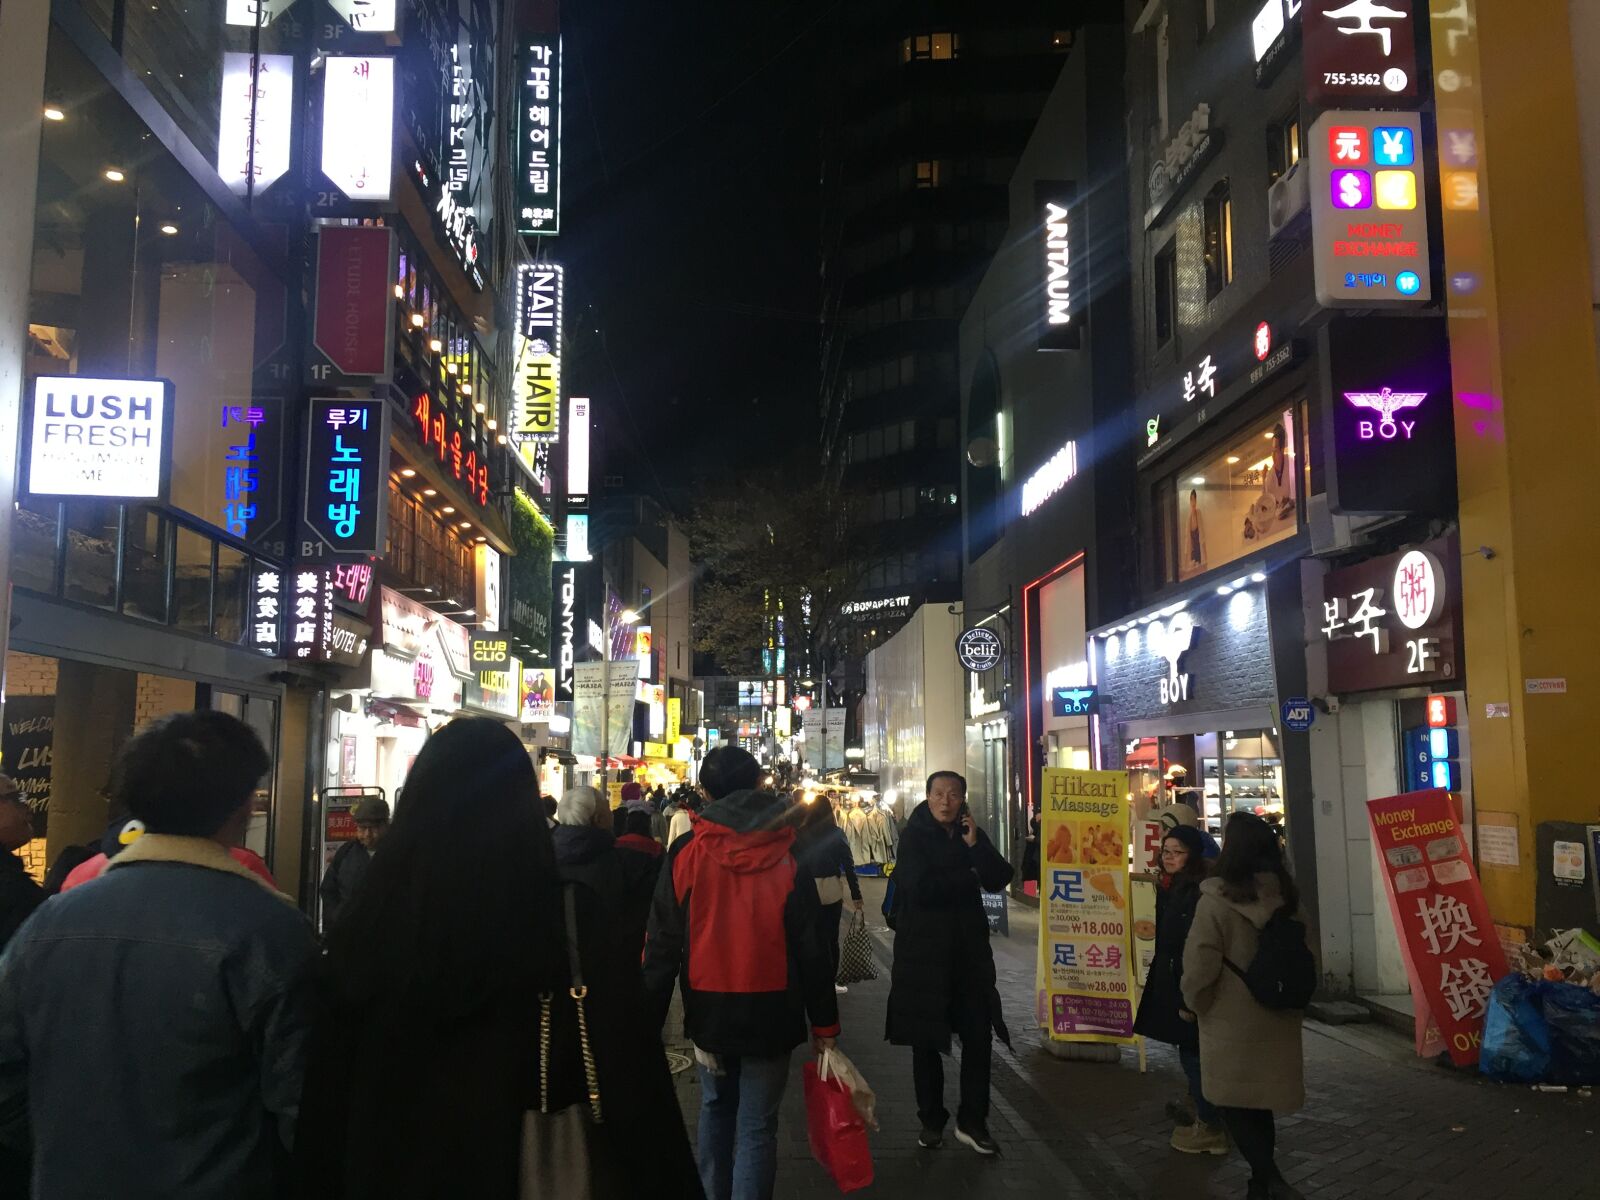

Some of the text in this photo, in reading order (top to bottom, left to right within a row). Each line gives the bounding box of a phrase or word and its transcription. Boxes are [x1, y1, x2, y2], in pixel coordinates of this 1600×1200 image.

[324, 24, 344, 39] 3F
[1323, 73, 1381, 86] 755-3562
[1335, 132, 1361, 160] 元
[317, 193, 338, 207] 2F
[1347, 223, 1404, 239] MONEY
[1333, 240, 1420, 257] EXCHANGE
[1046, 202, 1071, 324] ARITAUM
[528, 272, 555, 335] NAIL
[311, 365, 331, 379] 1F
[525, 363, 552, 427] HAIR
[45, 393, 153, 420] LUSH
[327, 408, 368, 430] 루키
[44, 423, 152, 447] FRESH
[1359, 421, 1416, 440] BOY
[327, 435, 362, 538] 노래방
[301, 542, 324, 557] B1
[332, 626, 357, 654] HOTEL
[561, 567, 575, 694] TONYMOLY
[474, 640, 506, 652] CLUB
[965, 643, 997, 656] belif
[1406, 637, 1429, 673] 2F
[473, 651, 506, 663] CLIO
[1160, 673, 1189, 704] BOY
[1064, 703, 1089, 713] BOY
[1286, 708, 1310, 721] ADT
[1419, 752, 1428, 763] 6
[1050, 775, 1119, 798] Hikari
[1420, 772, 1429, 782] 5
[1050, 796, 1119, 818] Massage
[1374, 807, 1416, 827] Money
[1391, 818, 1455, 842] Exchange
[1049, 870, 1085, 903] 足
[1057, 1022, 1071, 1032] 4F
